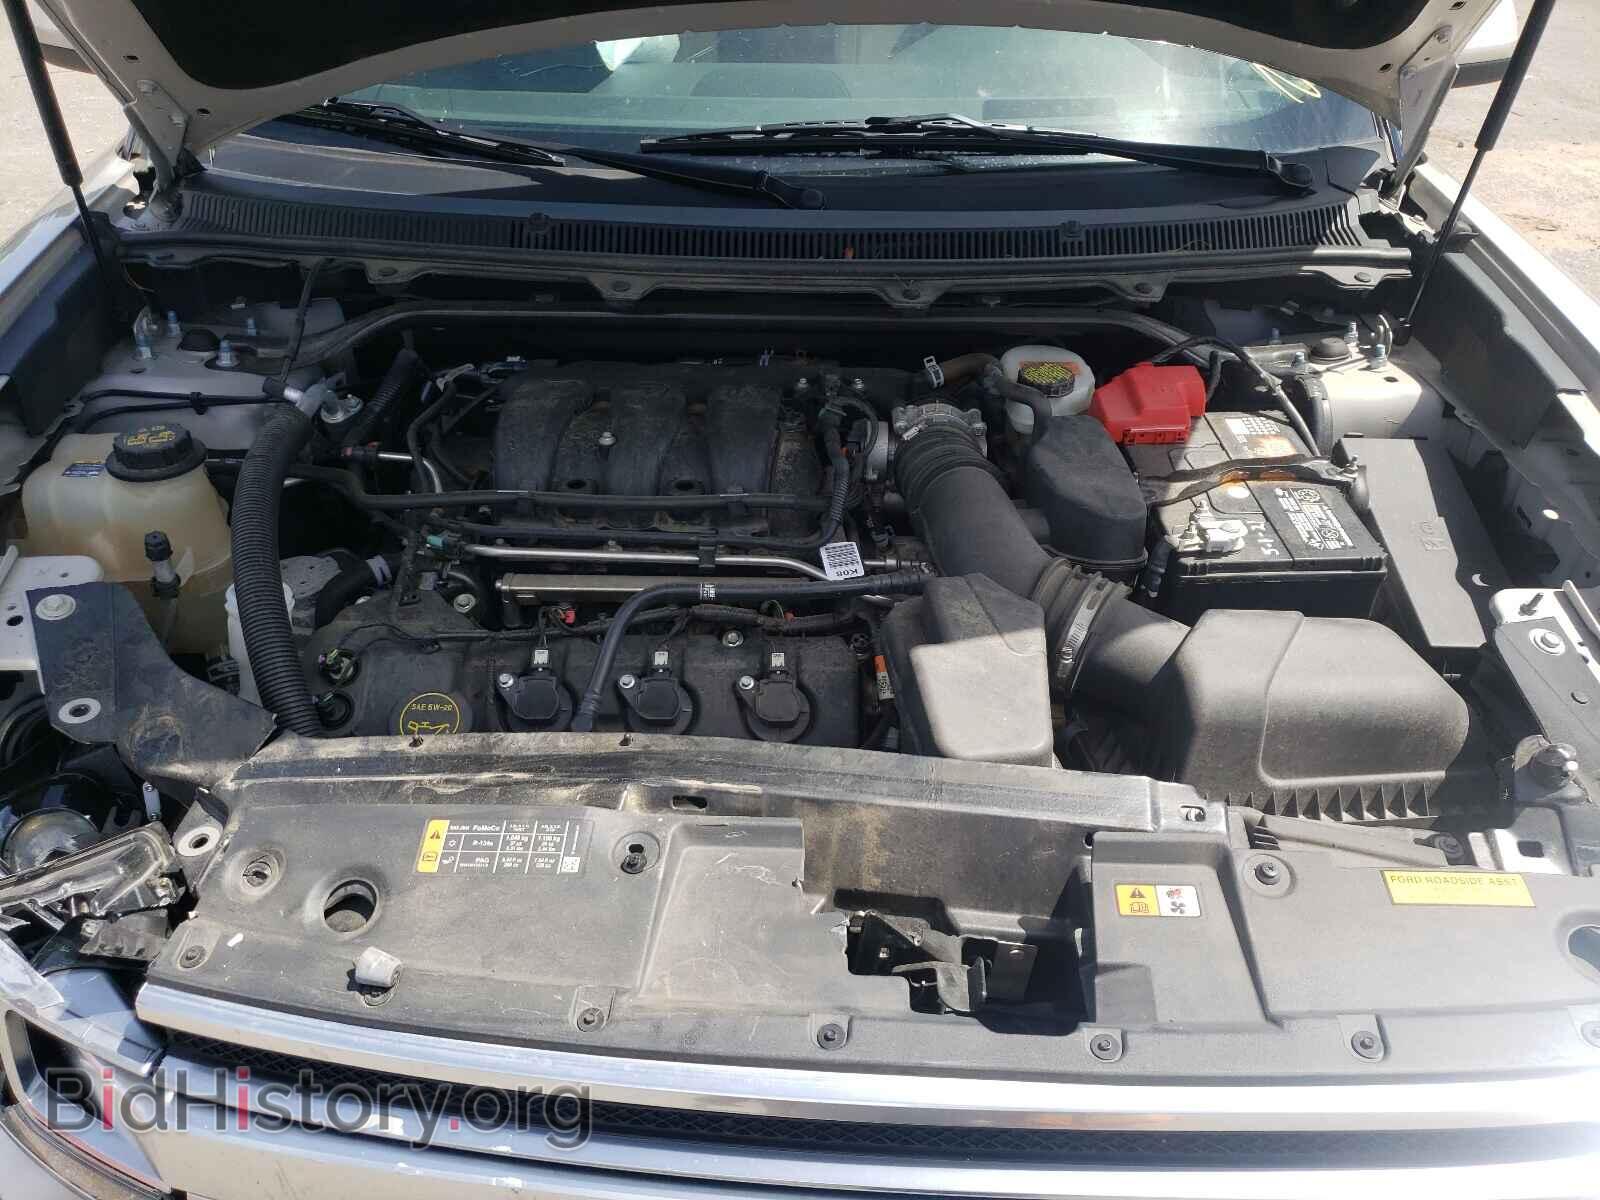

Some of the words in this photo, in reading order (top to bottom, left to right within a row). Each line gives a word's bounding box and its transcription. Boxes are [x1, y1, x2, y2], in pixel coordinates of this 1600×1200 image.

[411, 703, 427, 711] SAE
[1390, 875, 1422, 884] FORD
[1425, 876, 1484, 885] ROADSIDE
